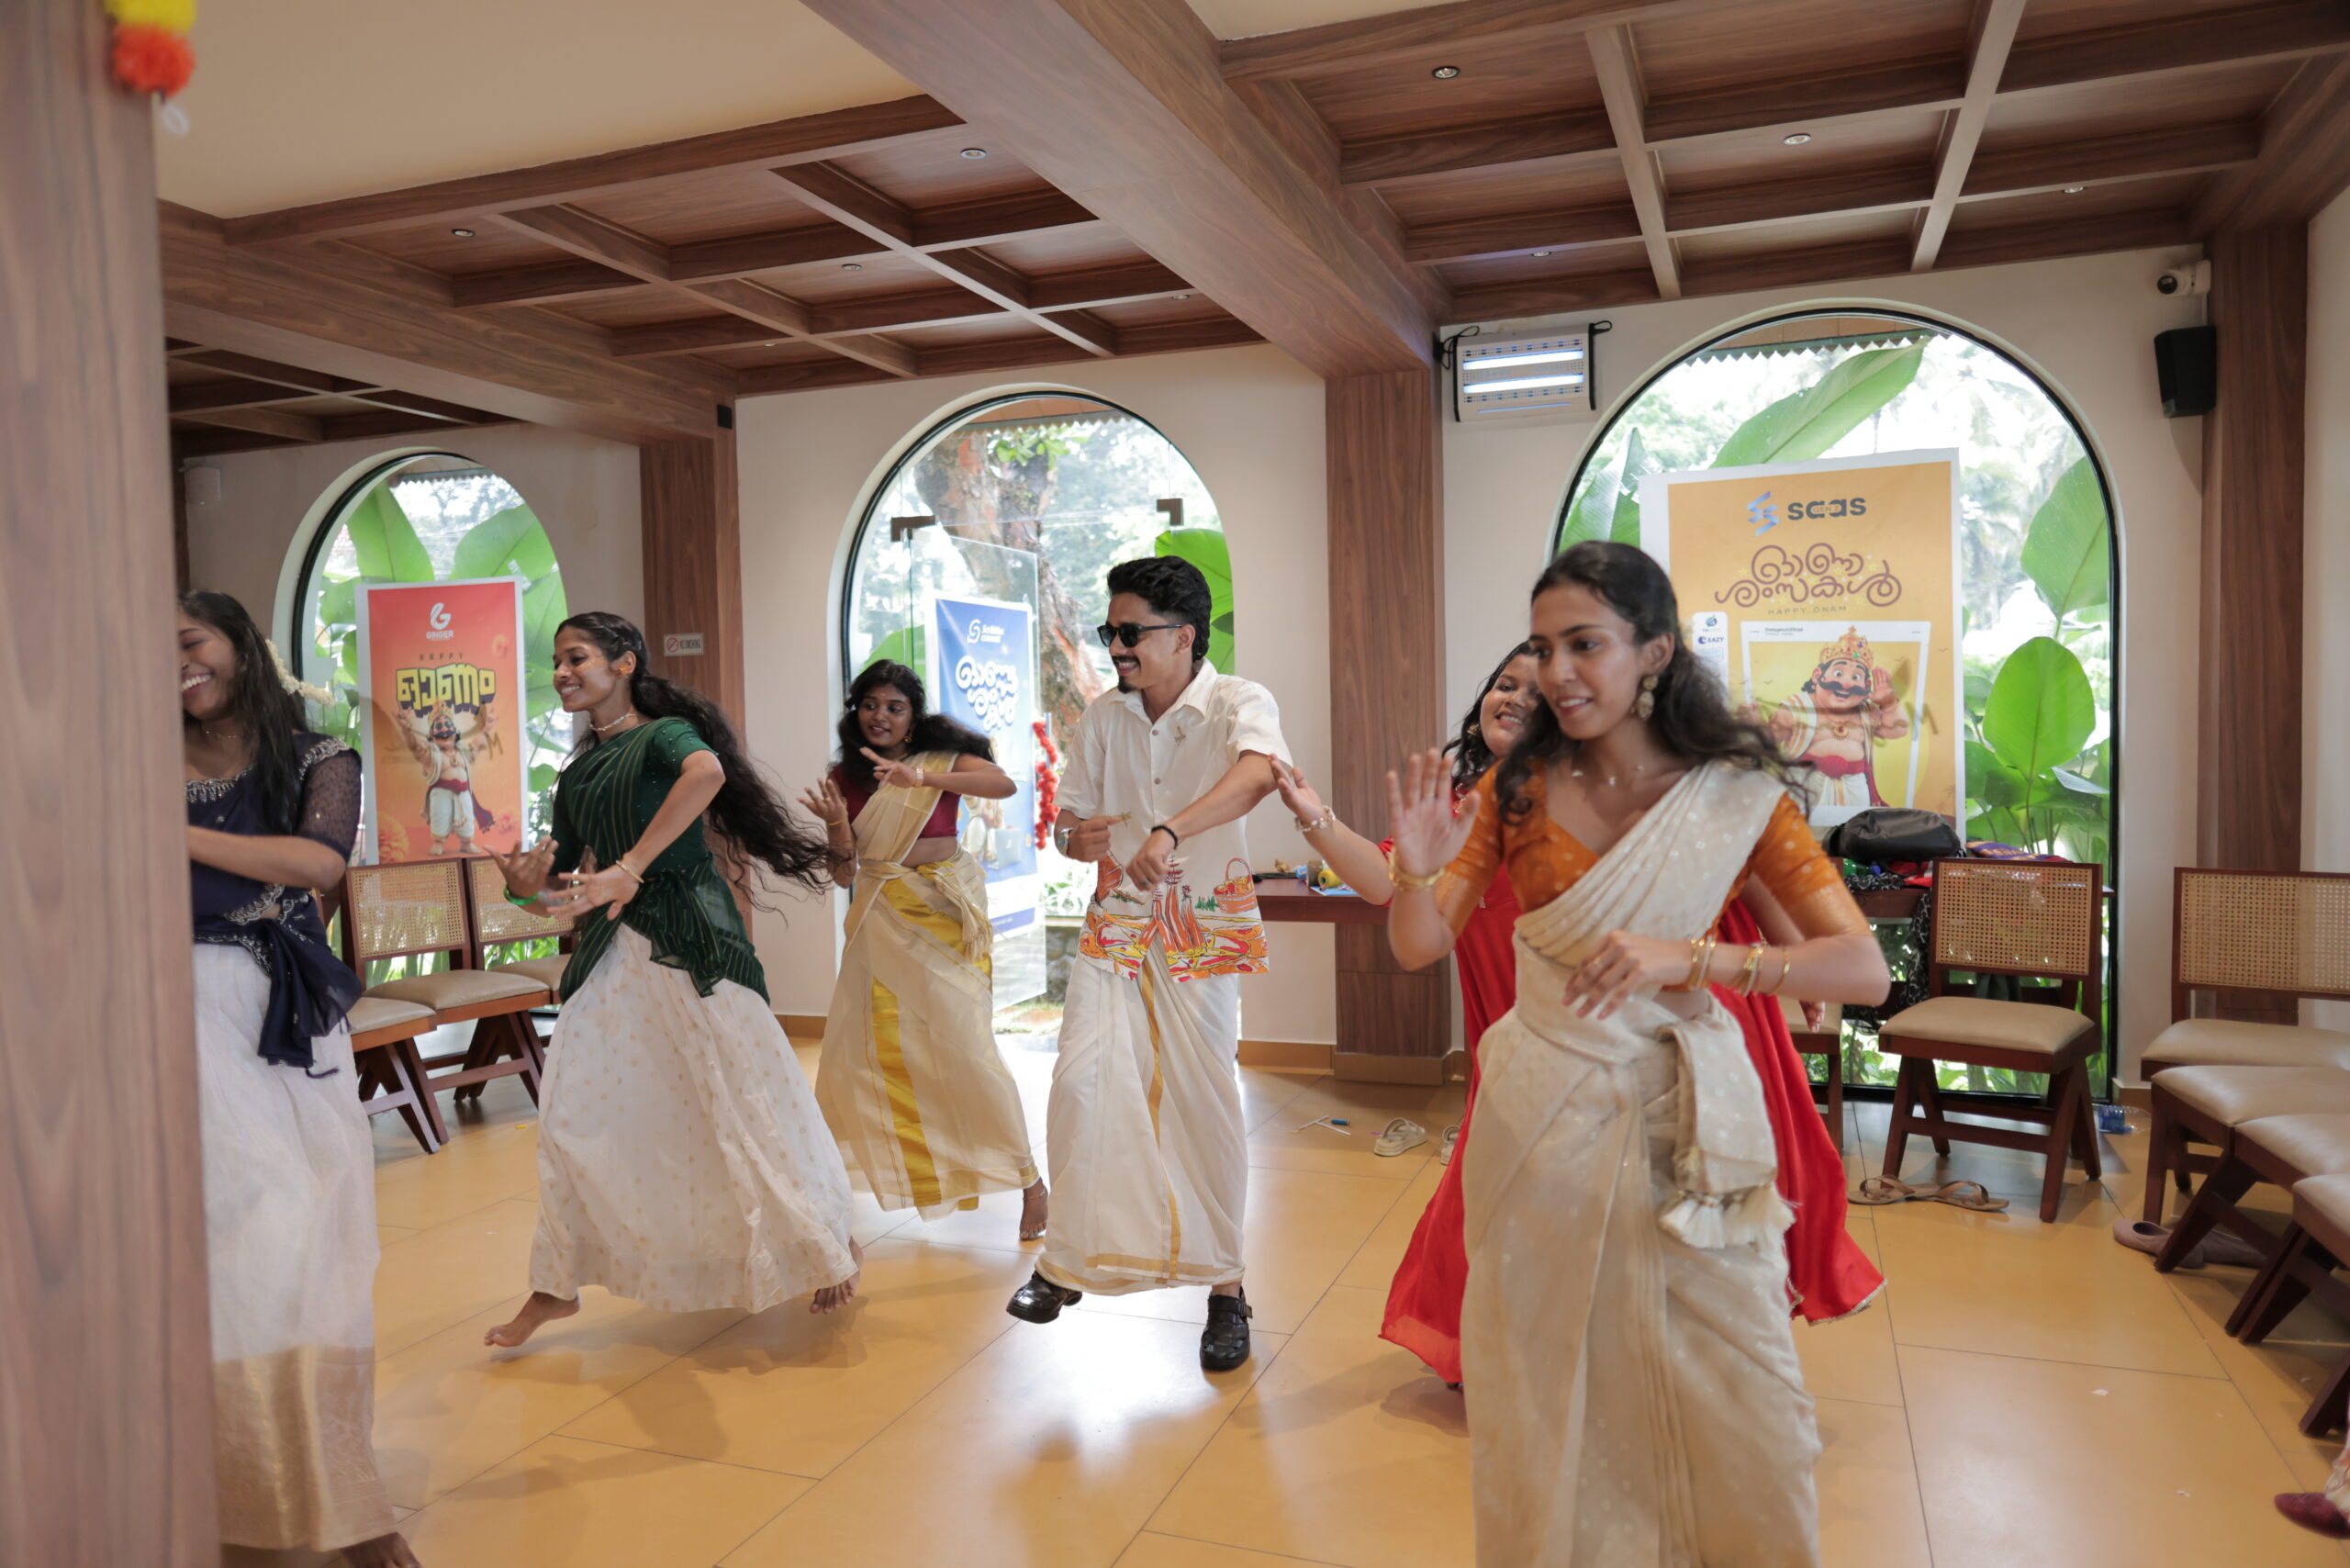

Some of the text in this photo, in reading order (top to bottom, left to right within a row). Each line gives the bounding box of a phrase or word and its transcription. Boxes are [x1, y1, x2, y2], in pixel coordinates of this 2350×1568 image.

[1768, 605, 1847, 616] HAPPY ONAM
[420, 653, 464, 661] HAPPY
[397, 663, 496, 711] ഓണം
